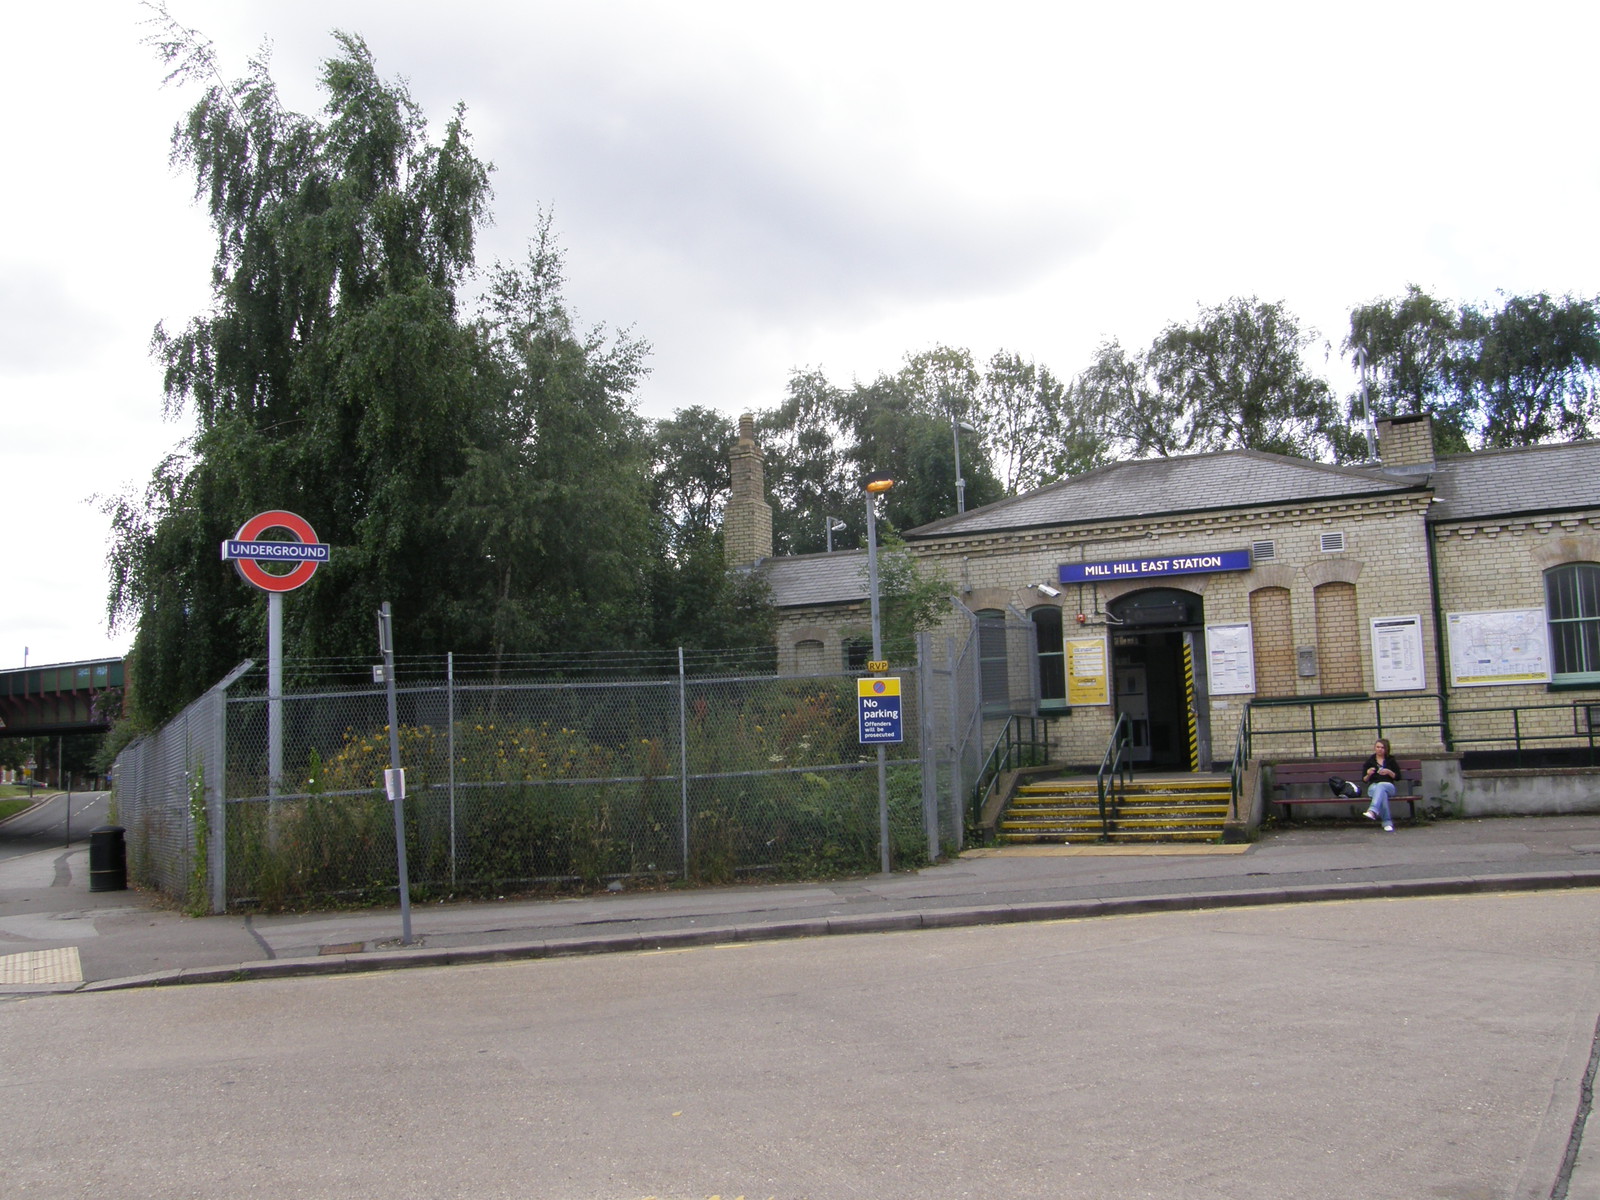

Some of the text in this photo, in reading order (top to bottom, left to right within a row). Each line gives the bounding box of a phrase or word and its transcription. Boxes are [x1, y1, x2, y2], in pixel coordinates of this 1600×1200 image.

[230, 544, 326, 558] UNDERGROUND
[1085, 556, 1221, 576] MILL HILL EAST STATION
[869, 662, 887, 670] RVP
[863, 699, 878, 708] No
[864, 709, 899, 720] parking
